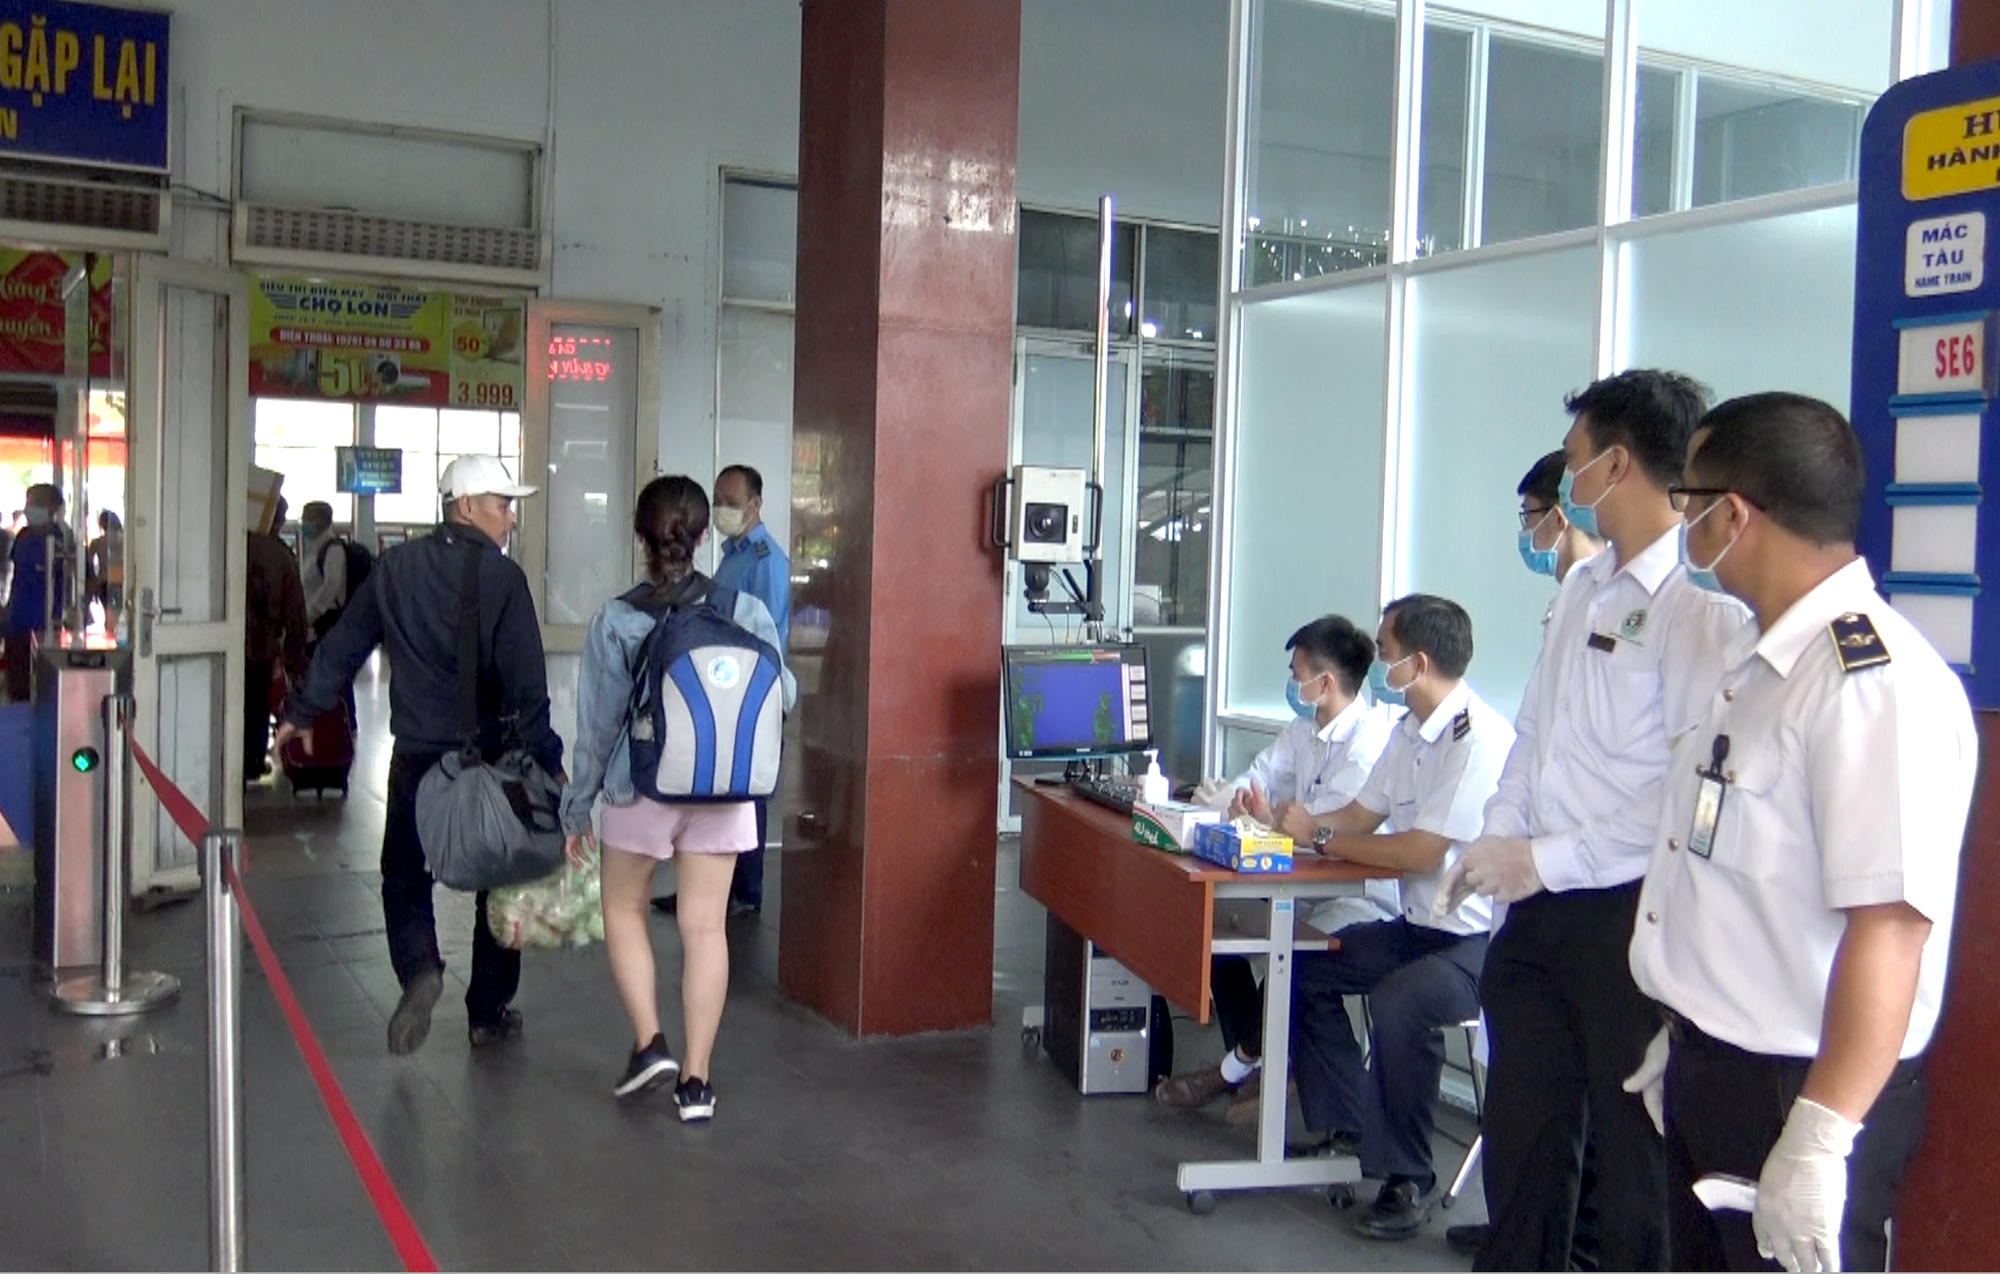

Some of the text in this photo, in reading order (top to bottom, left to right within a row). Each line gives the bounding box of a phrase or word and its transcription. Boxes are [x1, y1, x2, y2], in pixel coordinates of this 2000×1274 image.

[0, 14, 156, 119] GẶP LẠI
[1922, 221, 1968, 243] MÁC
[1923, 247, 1964, 268] TÀU
[1915, 270, 1972, 288] NAME TRAIN
[457, 335, 480, 352] 50
[1935, 334, 1974, 379] SE6
